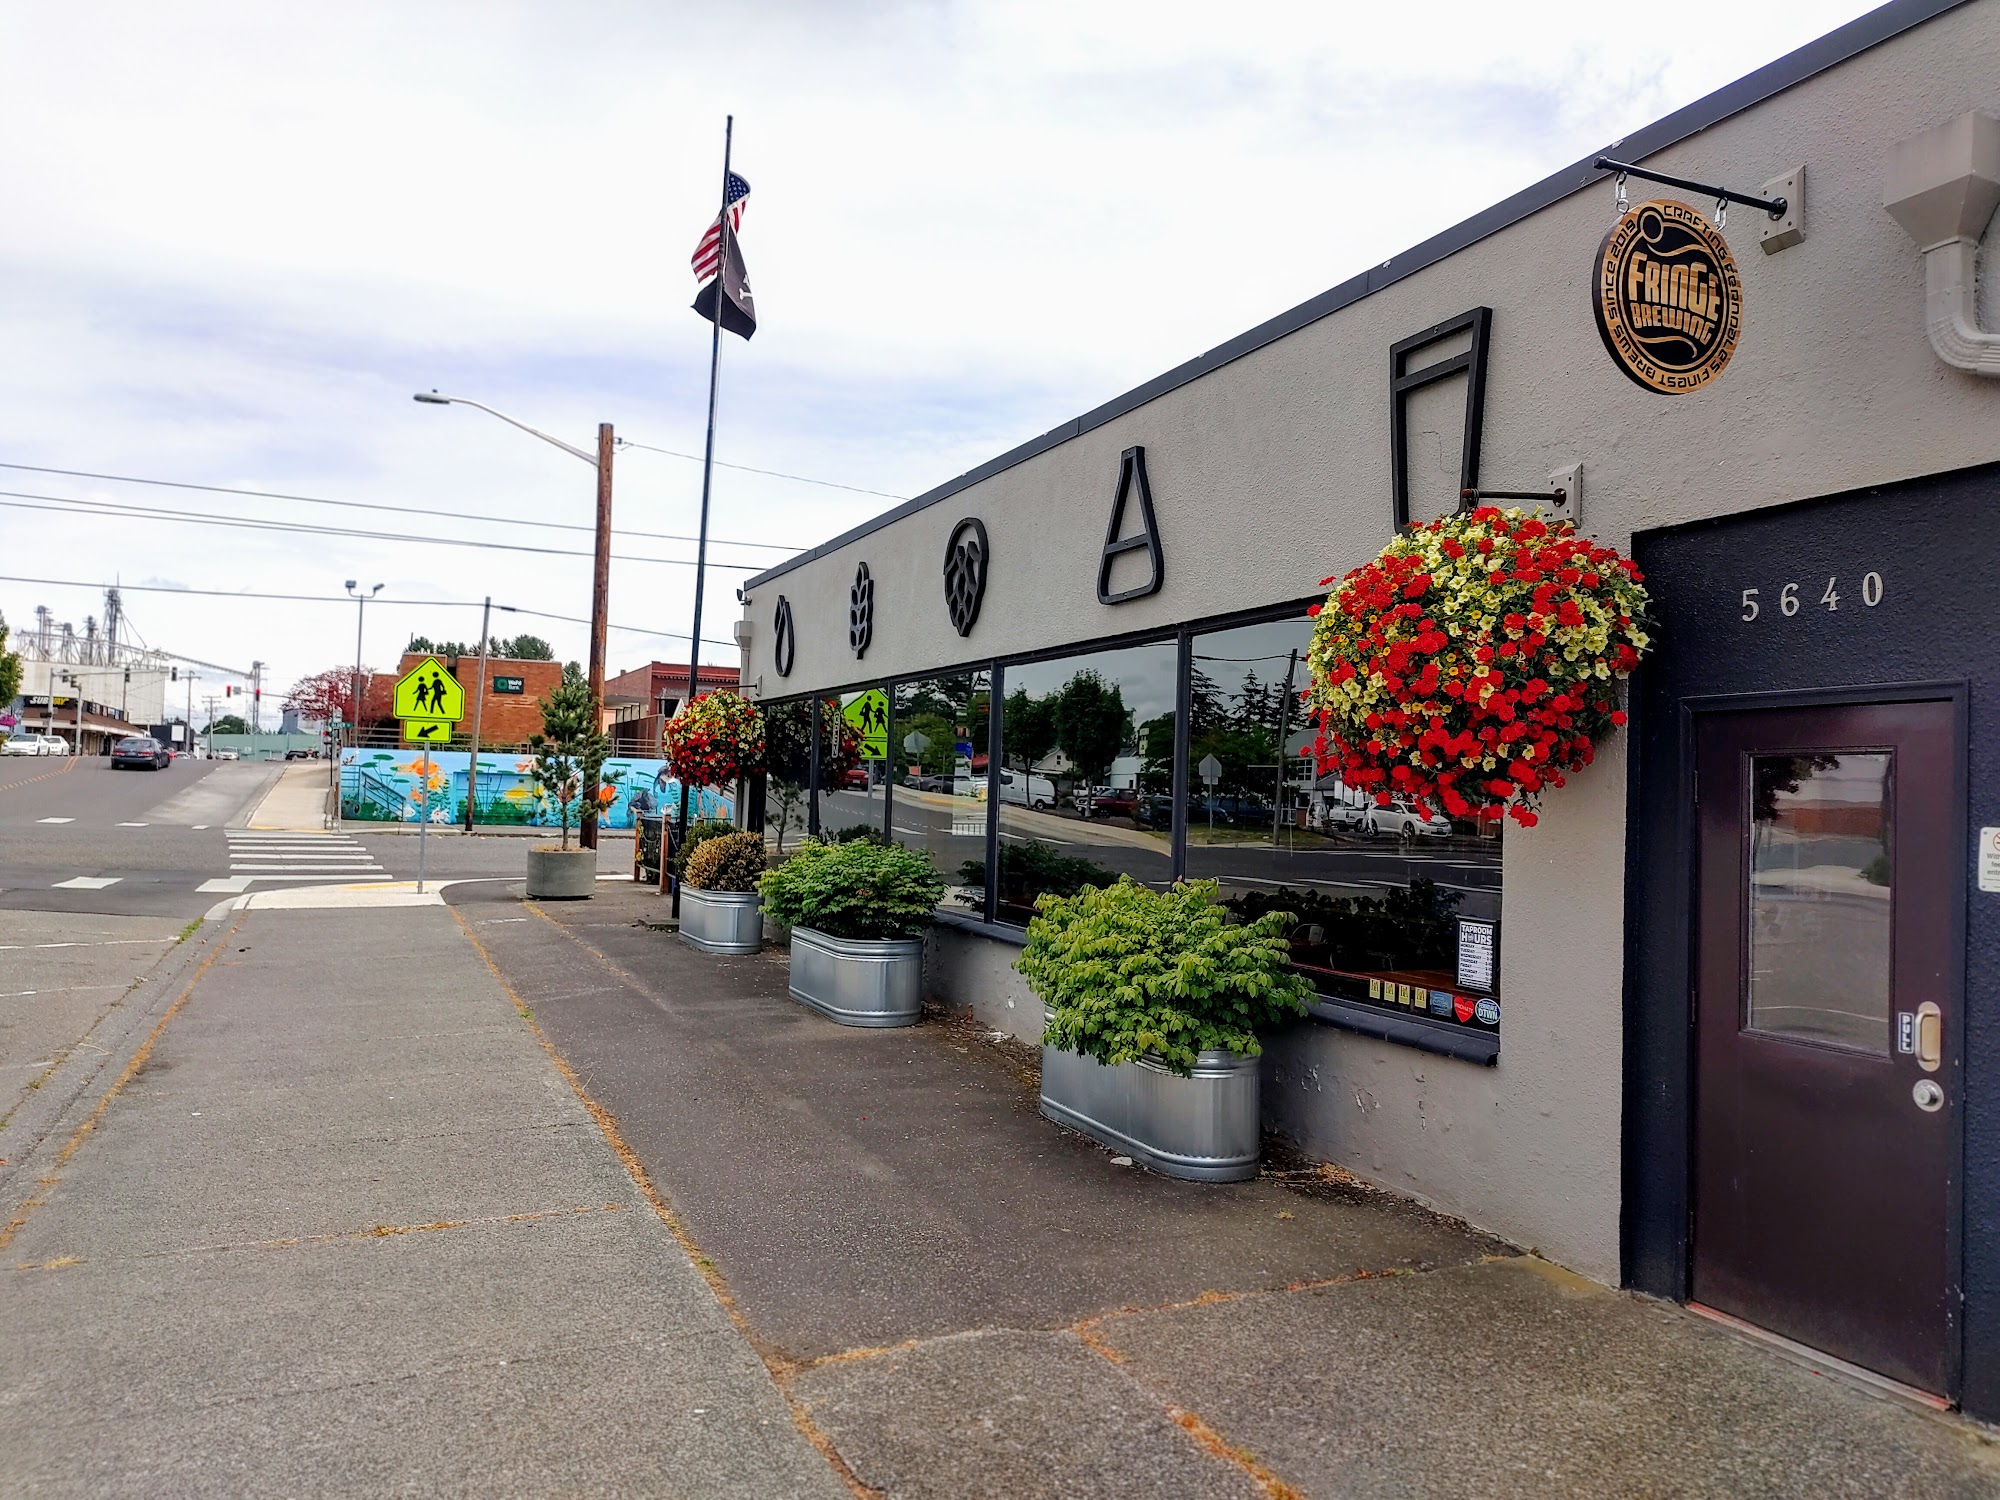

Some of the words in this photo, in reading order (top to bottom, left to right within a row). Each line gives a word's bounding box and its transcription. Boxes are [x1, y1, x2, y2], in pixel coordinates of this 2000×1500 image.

[1610, 219, 1636, 259] 2019
[1628, 251, 1721, 322] FRINGE
[1630, 303, 1716, 346] BREWING
[1613, 327, 1656, 379] BREWS
[1741, 571, 1885, 622] 5640
[1461, 924, 1492, 935] TAPROOM
[1902, 1014, 1911, 1050] PULL
